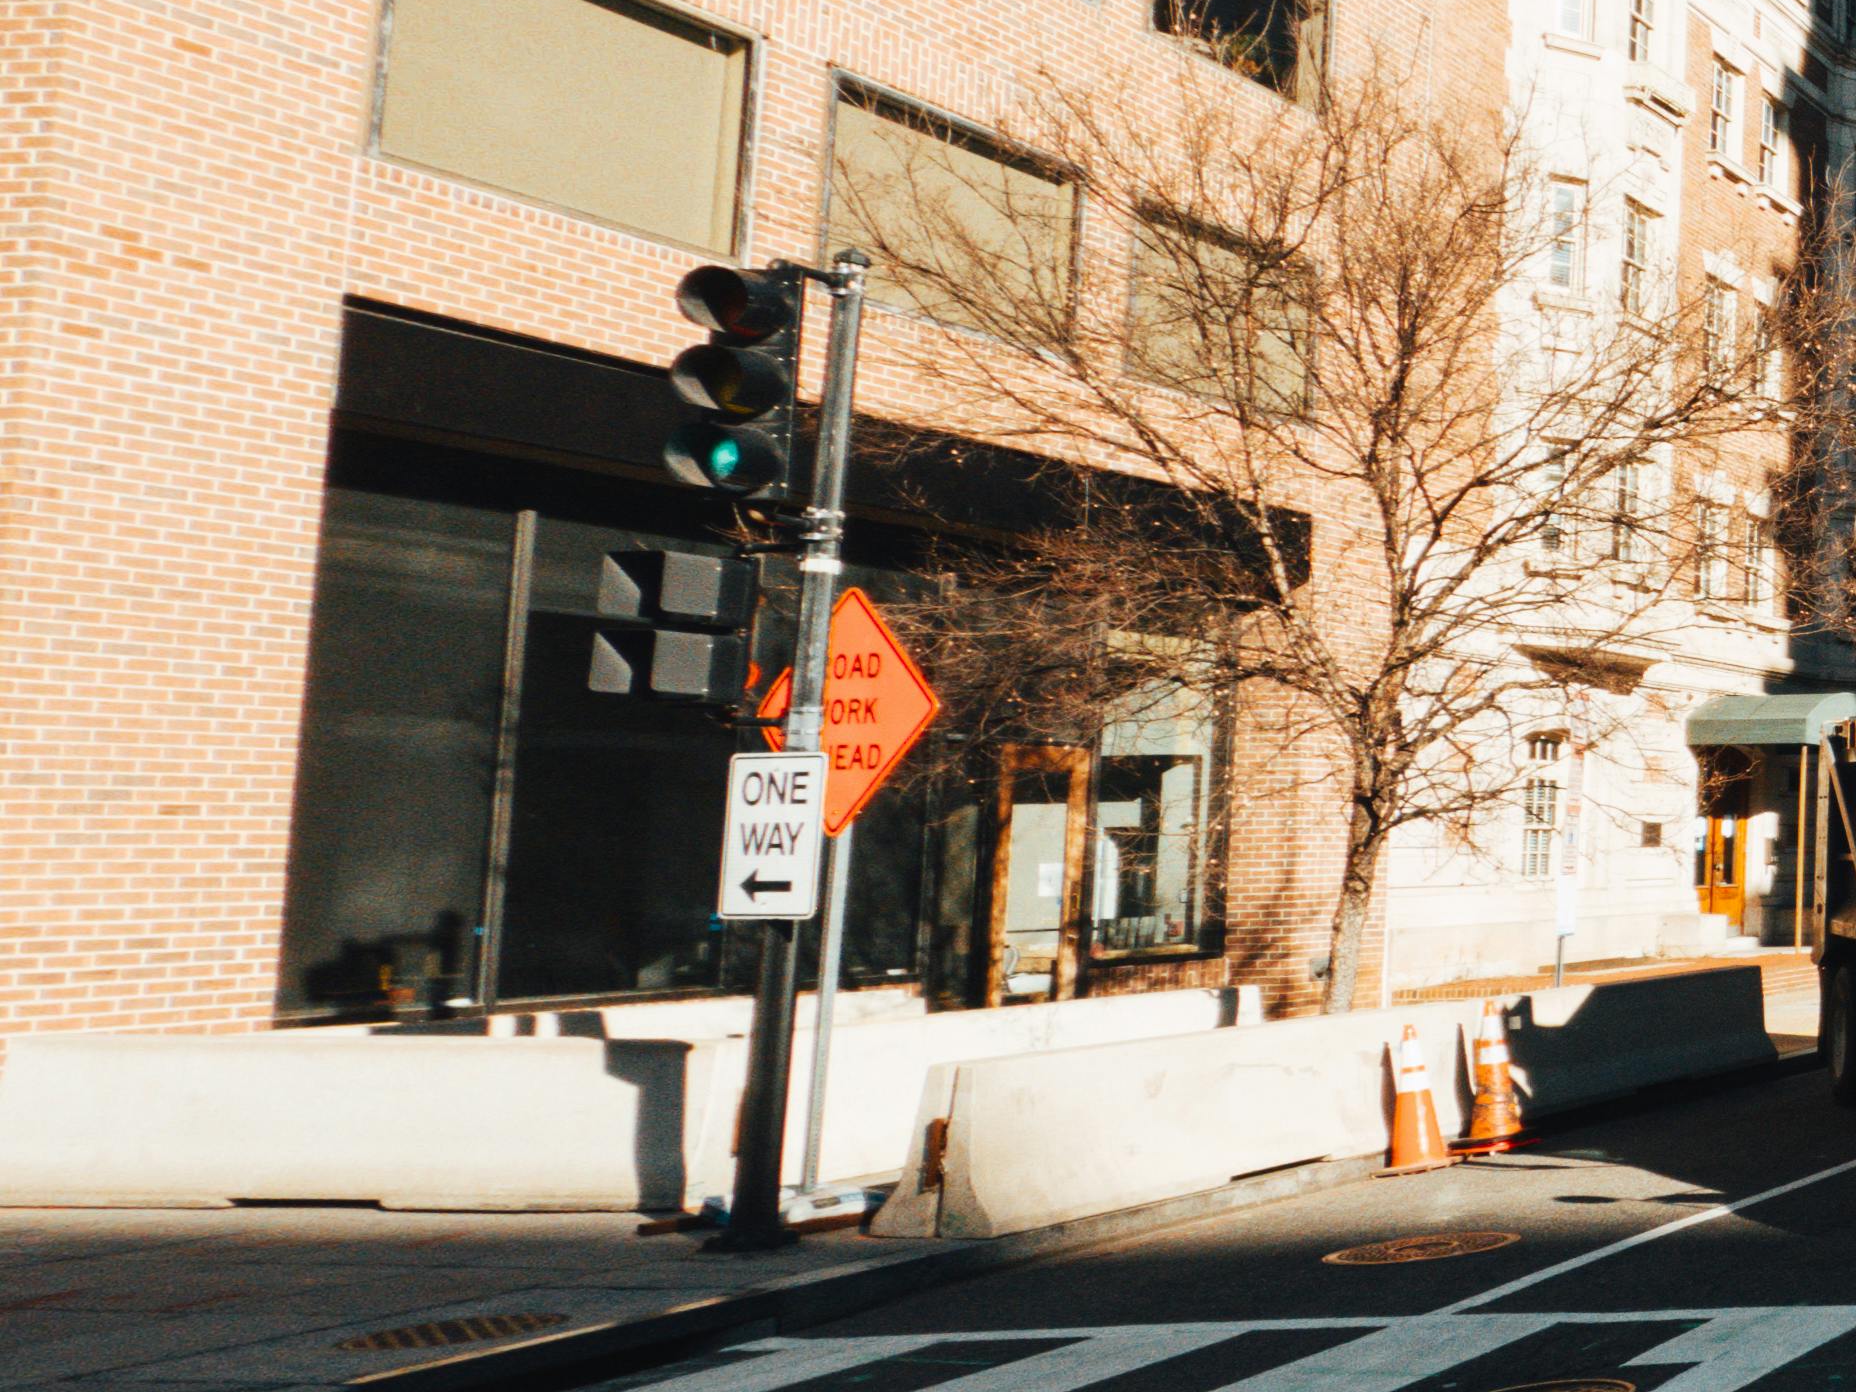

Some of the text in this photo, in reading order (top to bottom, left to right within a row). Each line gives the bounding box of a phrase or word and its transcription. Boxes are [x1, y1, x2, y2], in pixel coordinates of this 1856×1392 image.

[832, 653, 881, 680] OAD
[827, 698, 878, 726] ORK
[829, 743, 881, 770] EAD
[743, 771, 811, 806] ONE
[740, 822, 805, 856] WAY
